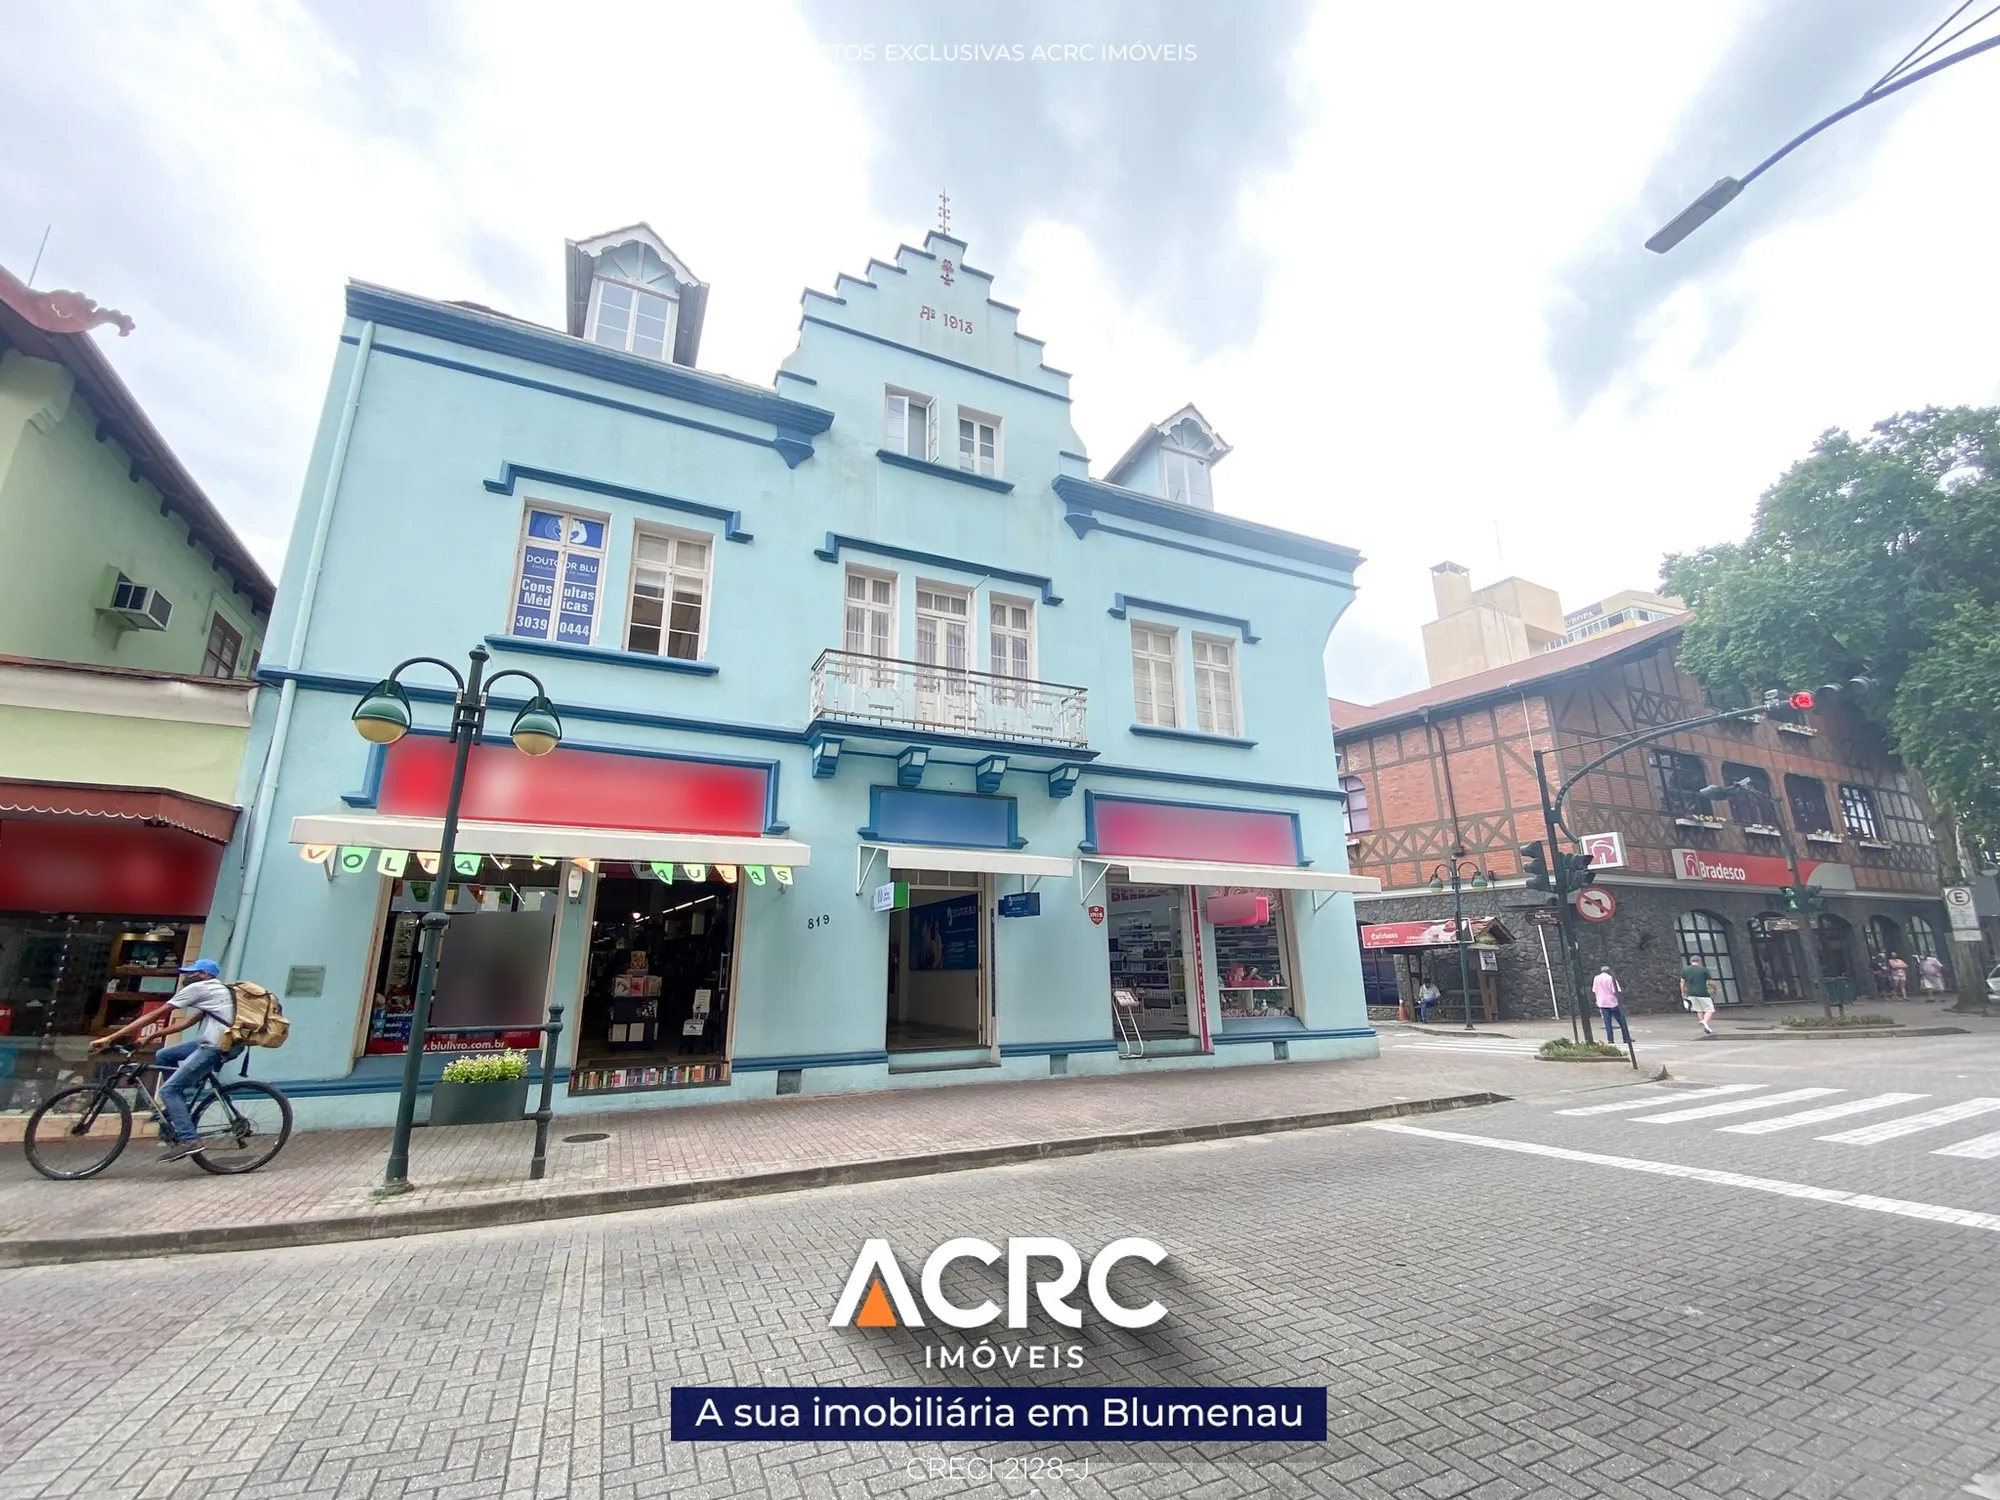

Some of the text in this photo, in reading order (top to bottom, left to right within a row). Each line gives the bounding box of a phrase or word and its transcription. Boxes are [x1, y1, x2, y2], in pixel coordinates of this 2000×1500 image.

[942, 313, 974, 335] 1913
[579, 563, 597, 573] BLU
[516, 615, 590, 637] 3039 0444
[1700, 861, 1746, 882] Bradesco
[1954, 892, 1964, 903] E
[807, 914, 830, 929] 819
